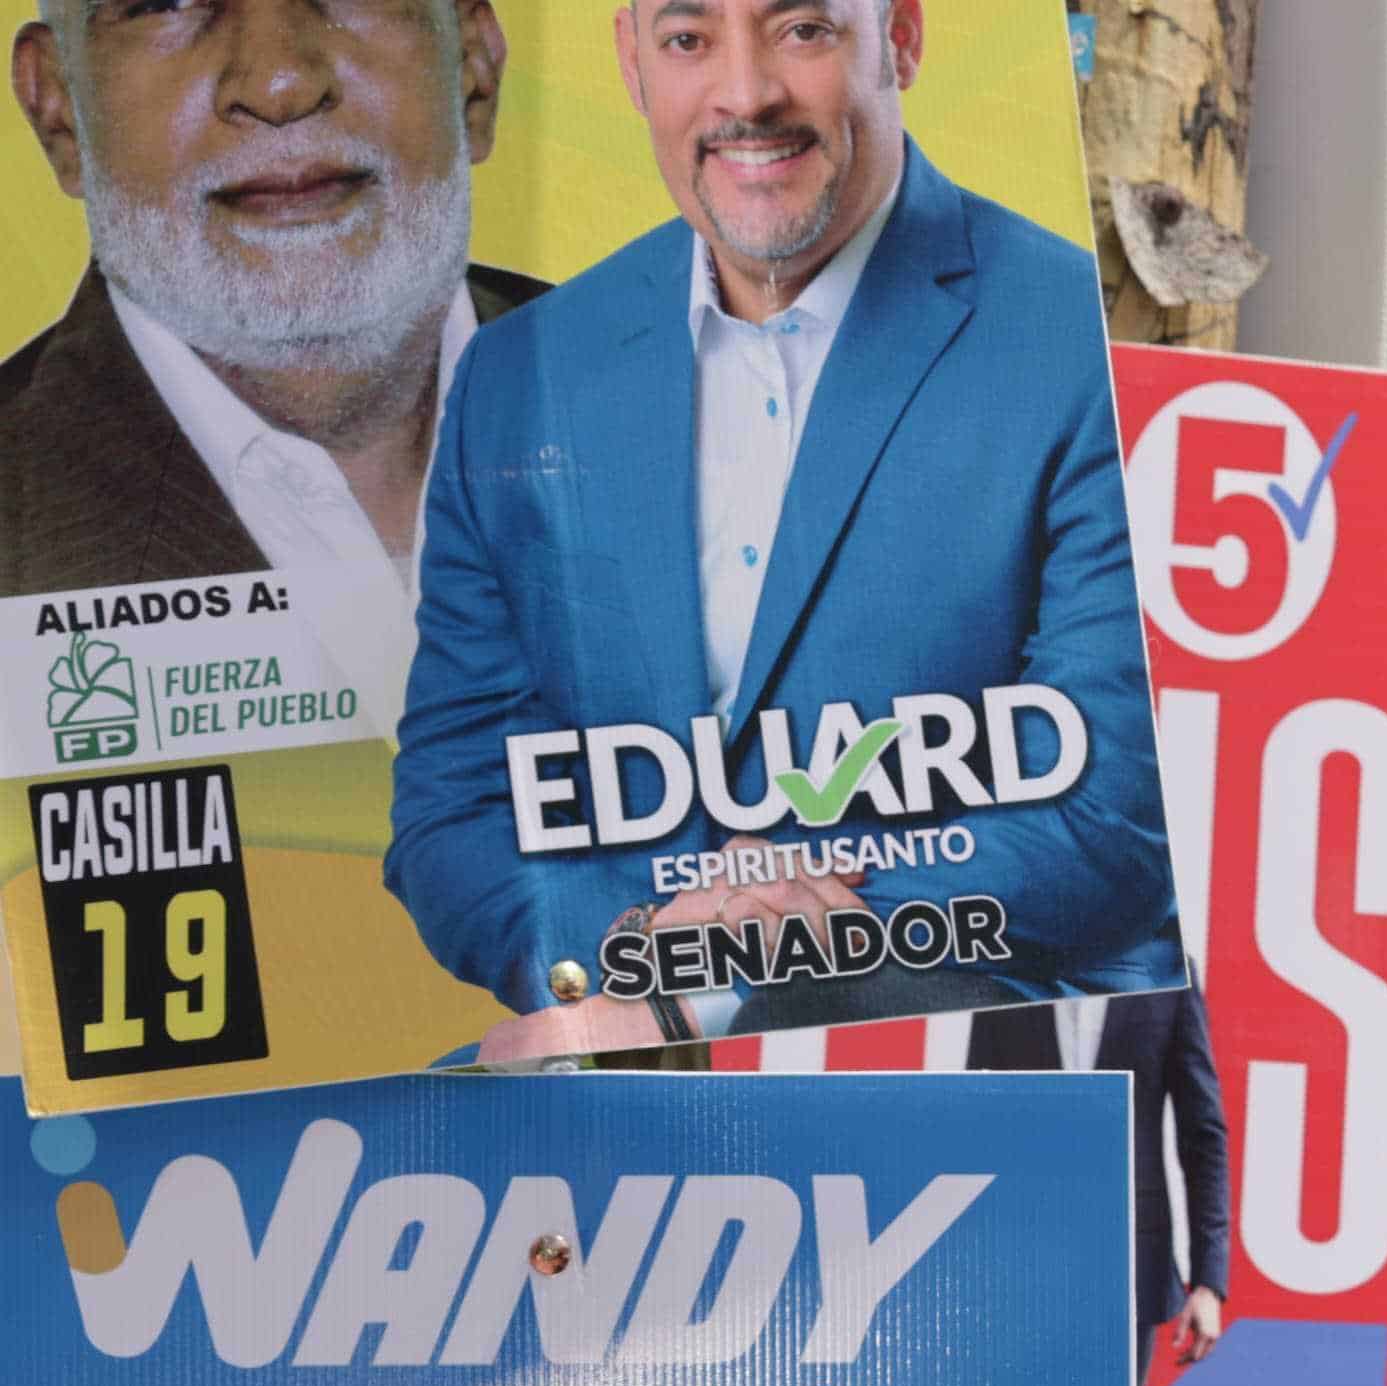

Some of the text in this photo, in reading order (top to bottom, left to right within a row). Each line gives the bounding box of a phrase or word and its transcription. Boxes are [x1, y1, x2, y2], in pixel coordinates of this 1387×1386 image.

[36, 581, 289, 636] ALIADOS A:
[165, 656, 282, 697] FUERZA
[170, 688, 357, 737] DEL PUEBLO
[61, 729, 133, 759] FP
[505, 683, 1089, 854] EDUARD
[40, 773, 233, 883] CASILLA
[650, 825, 976, 894] ESPIRITUSANTO
[83, 888, 228, 1054] 19
[600, 896, 1011, 999] SENADOR
[56, 1118, 998, 1368] WANDY
